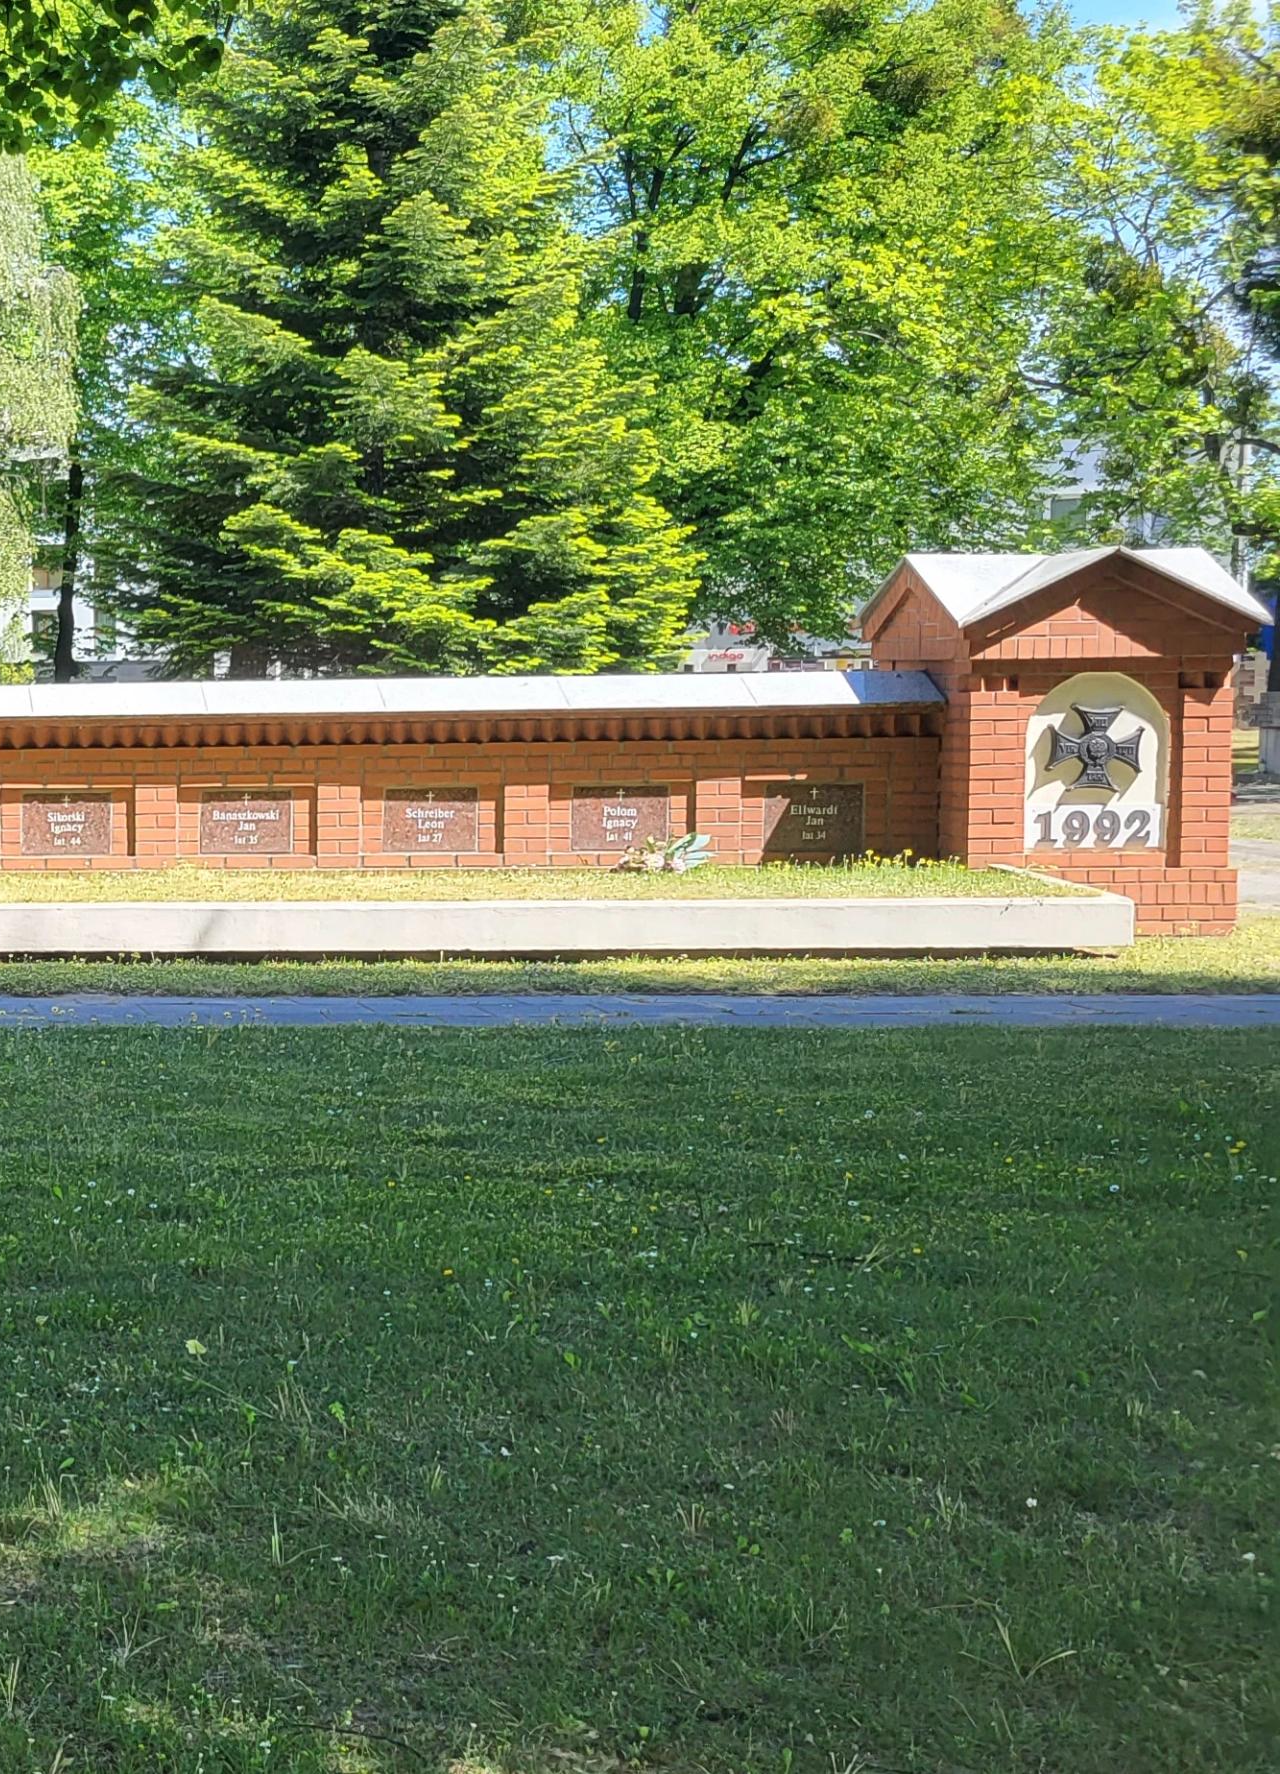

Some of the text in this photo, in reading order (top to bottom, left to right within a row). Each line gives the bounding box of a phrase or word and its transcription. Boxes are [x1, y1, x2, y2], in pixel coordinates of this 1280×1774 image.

[47, 811, 85, 822] Sikorski
[212, 809, 279, 820] Banaszkowski
[405, 807, 455, 818] Schreiber
[238, 821, 256, 831] Jan
[418, 819, 444, 829] Leon
[602, 817, 638, 829] Ignacy
[805, 816, 824, 826] Jan
[1033, 810, 1151, 842] 1992
[50, 822, 84, 834] Ignacy
[70, 837, 81, 846] 44
[432, 833, 443, 843] 27
